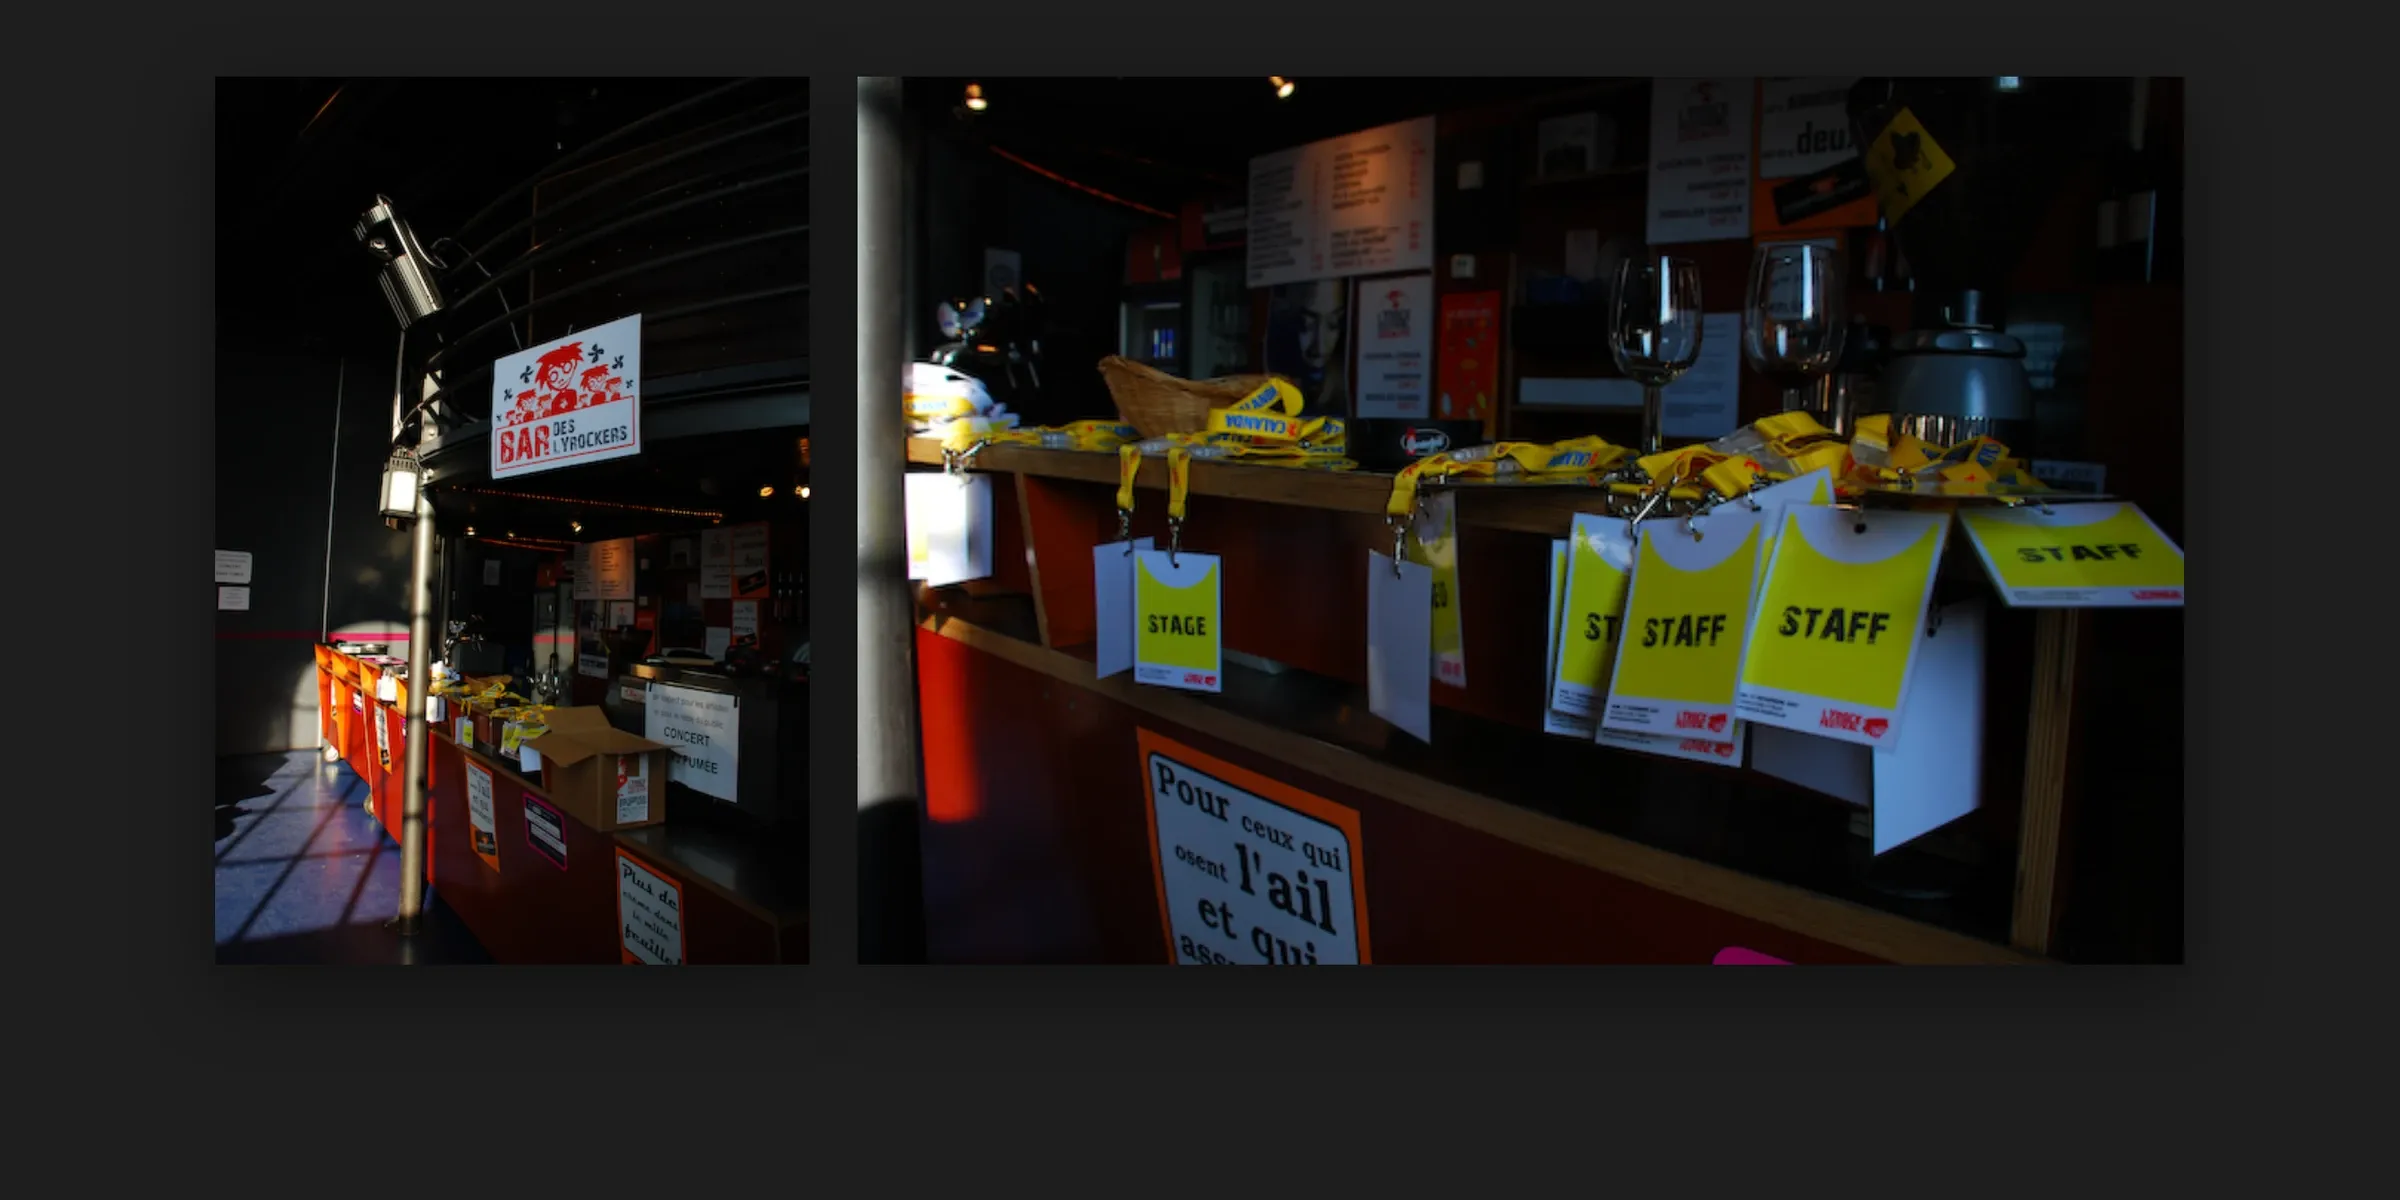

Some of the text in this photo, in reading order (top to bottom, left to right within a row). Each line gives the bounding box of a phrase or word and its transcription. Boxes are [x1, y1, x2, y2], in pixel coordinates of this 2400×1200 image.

[1797, 121, 1852, 154] deu
[500, 424, 550, 464] BAR
[553, 419, 575, 437] DES
[553, 425, 628, 455] LYROCKERS
[2016, 542, 2143, 563] STAFF
[1148, 613, 1207, 636] STAGE
[1584, 612, 1619, 643] ST
[1642, 613, 1727, 648] STAFF
[1778, 605, 1890, 645] STAFF
[664, 726, 711, 747] CONCERT
[1156, 762, 1343, 872] Pour ceux qui
[622, 863, 679, 912] Plus de
[1175, 842, 1337, 936] osent l'ail
[1198, 898, 1318, 965] et qui
